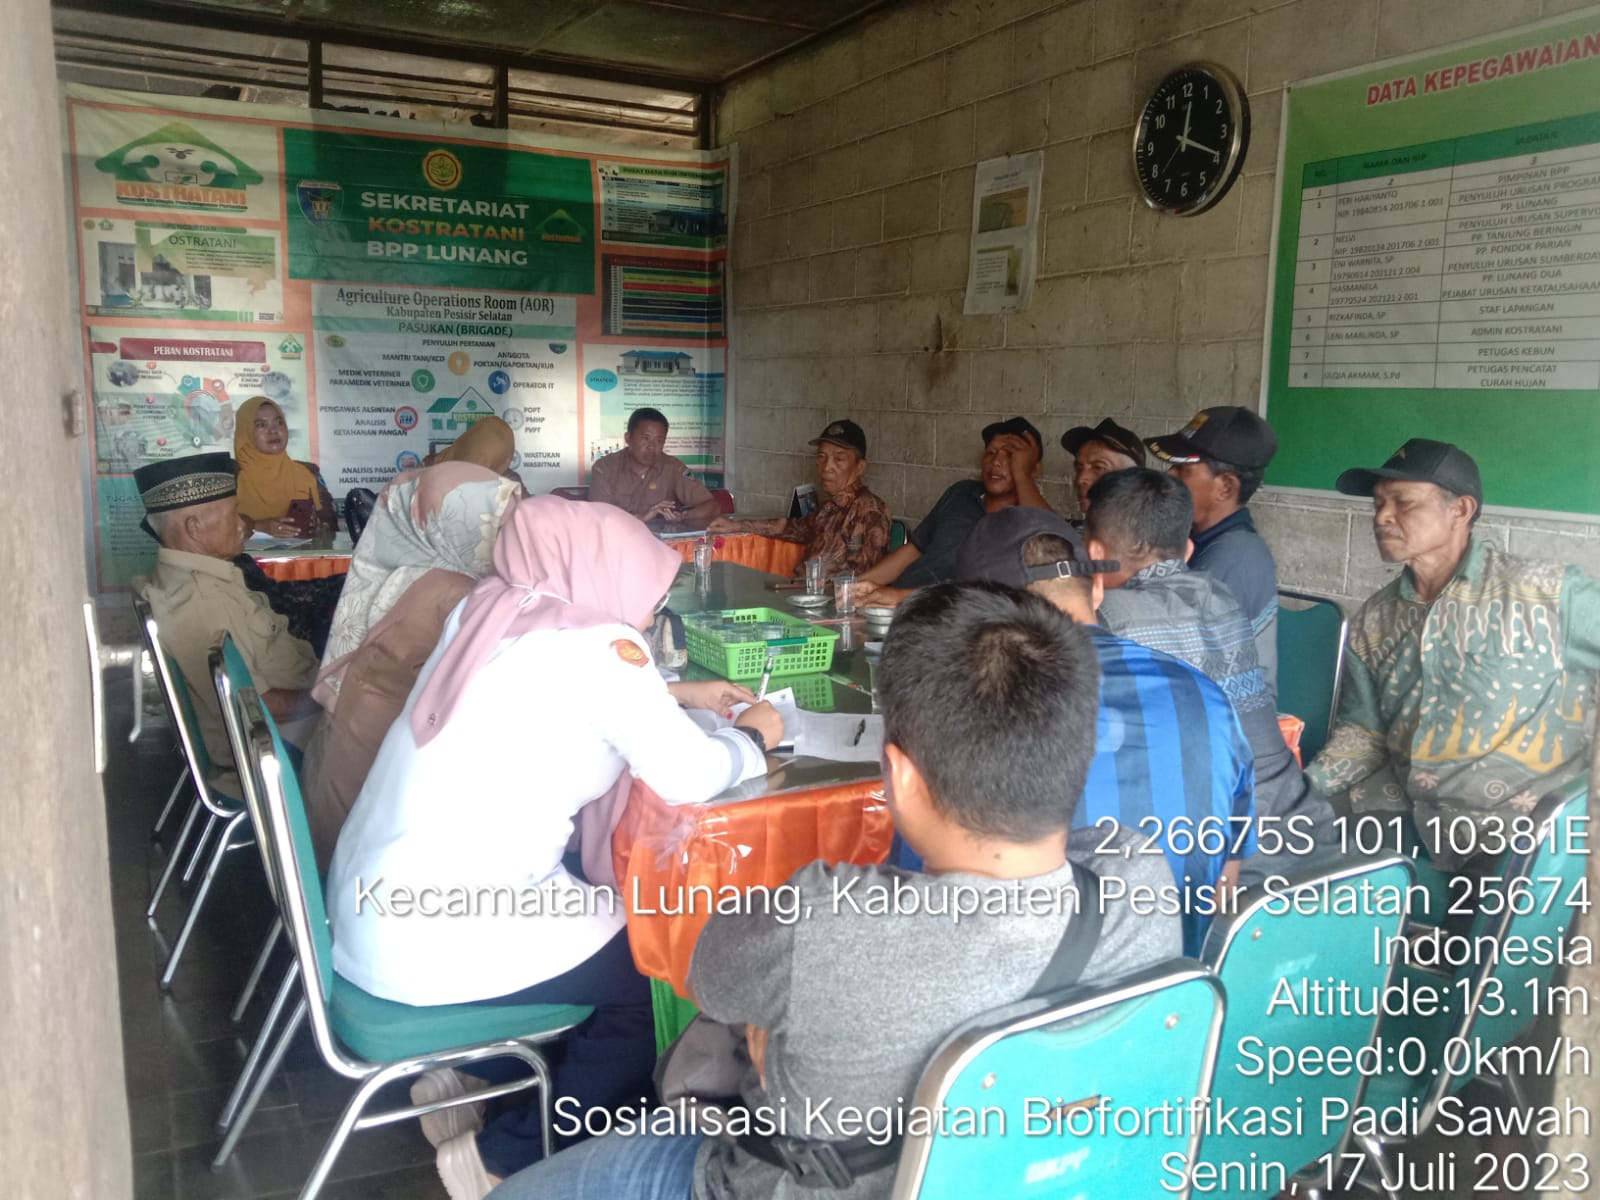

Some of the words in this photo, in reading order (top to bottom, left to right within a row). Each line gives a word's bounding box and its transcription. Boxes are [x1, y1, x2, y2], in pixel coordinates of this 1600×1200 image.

[1366, 76, 1418, 106] DATA
[1423, 31, 1600, 94] KEPEGAWAIAN
[1182, 82, 1193, 97] 12
[1203, 85, 1208, 100] 1
[1166, 95, 1175, 109] 11
[1215, 99, 1222, 114] 2
[1155, 114, 1165, 129] 10
[1220, 123, 1227, 139] 3
[1147, 142, 1154, 156] 9
[1151, 164, 1158, 178] 8
[1199, 171, 1206, 186] 5
[1498, 168, 1548, 183] PIMPINAN
[1550, 166, 1571, 177] BPP
[1164, 178, 1171, 193] 7
[1180, 182, 1188, 197] 6
[1458, 189, 1508, 202] PENYULUH
[1510, 183, 1551, 196] URUSAN
[116, 183, 247, 205] KOSTRATANI
[361, 192, 530, 220] SEKRETARIAT
[1516, 196, 1559, 210] LUNANG
[1458, 217, 1508, 230] PENYULUH
[1510, 212, 1551, 225] URUSAN
[369, 217, 525, 241] KOSTRATANI
[1486, 228, 1531, 241] TANJUNG
[1533, 223, 1583, 236] BERINGIN
[367, 241, 419, 258] BPP
[426, 244, 528, 266] LUNANG
[1490, 242, 1533, 254] PONDOK
[1535, 239, 1572, 250] PARIAN
[1448, 261, 1495, 272] PENYULUH
[1497, 256, 1537, 268] URUSAN
[1496, 271, 1538, 281] LUNANG
[1540, 269, 1562, 279] DUA
[1442, 288, 1477, 299] PEJABAT
[1479, 286, 1518, 297] URUSAN
[336, 288, 410, 305] Agriculture
[414, 292, 481, 310] Operations
[484, 295, 517, 310] Room
[520, 297, 555, 316] (AOR)
[1479, 305, 1501, 315] STAF
[1502, 303, 1555, 314] LAPANGAN
[386, 306, 441, 319] Kabupaten
[443, 308, 476, 320] Pesisir
[478, 309, 512, 322] Selatan
[398, 322, 454, 334] PASUKAN
[456, 324, 513, 338] (BRIGADE)
[1471, 327, 1503, 337] ADMIN
[1505, 325, 1563, 335] KOSTRATANI
[153, 346, 182, 356] PERAN
[183, 347, 234, 357] KOSTRATANI
[382, 353, 411, 362] MANTRI
[1478, 348, 1520, 357] PETUGAS
[1521, 346, 1555, 356] KEBUN
[1467, 364, 1509, 374] PETUGAS
[1511, 364, 1558, 374] PENCATAT
[513, 381, 547, 390] OPERATOR
[1480, 378, 1513, 388] CURAH
[1514, 378, 1546, 388] HUJAN
[319, 405, 361, 414] PENGAWAS
[333, 429, 378, 437] KETAHANAN
[378, 429, 407, 437] PANGAN
[339, 476, 359, 484] HASIL
